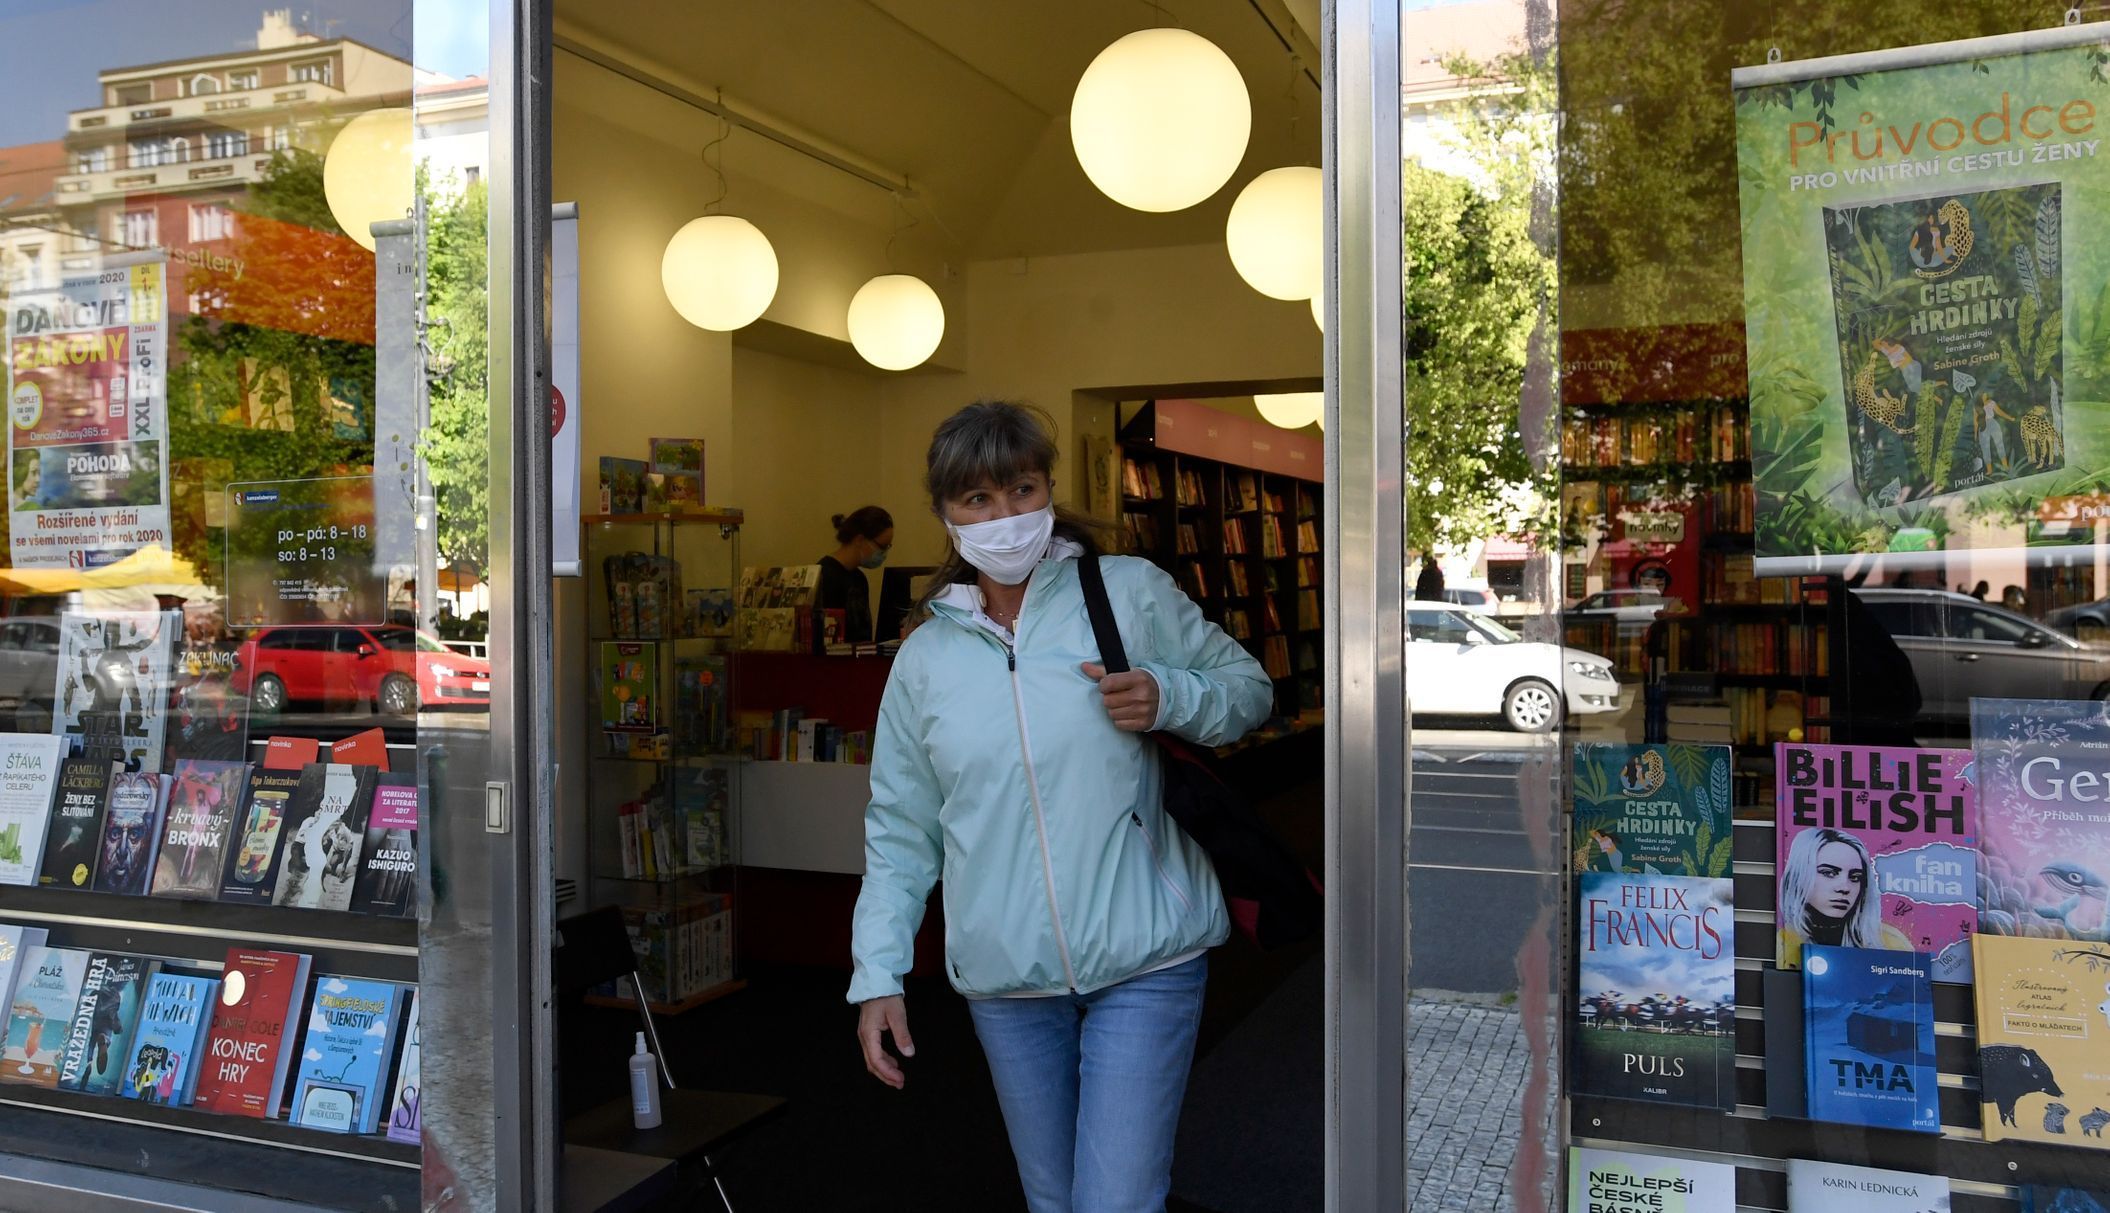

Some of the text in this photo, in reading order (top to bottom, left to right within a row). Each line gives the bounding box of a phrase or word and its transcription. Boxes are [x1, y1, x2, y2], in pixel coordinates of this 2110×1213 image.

[1787, 91, 2097, 169] Průvodce
[1790, 139, 2100, 192] PRO VNITŘNÍ CESTU ŽENY
[99, 271, 125, 284] 2020
[1920, 275, 1999, 307] CESTA
[1910, 297, 2018, 336] HRDINKY
[1937, 328, 1993, 343] Hledání zdrojů
[15, 332, 126, 369] ZÁKONY
[1945, 340, 1986, 353] ženské síly
[1710, 351, 1740, 367] pro
[1934, 351, 2000, 371] Sabine Groth
[135, 399, 151, 436] XXL
[67, 453, 132, 474] POHODA
[1954, 471, 1985, 488] portál
[37, 509, 138, 529] Rozšířené vydání
[16, 529, 163, 546] se všemi novelami pro rok 2020
[278, 529, 294, 544] po
[307, 526, 327, 543] pá:
[330, 525, 337, 539] 8
[352, 525, 367, 539] 18
[278, 550, 296, 561] so:
[299, 547, 307, 561] 8
[320, 547, 336, 560] 13
[66, 710, 148, 738] STAR
[334, 740, 357, 753] novinka
[6, 752, 42, 769] ŠŤÁVA
[2, 772, 47, 782] ŘAPÍKATÉHO
[67, 764, 104, 775] CAMILLA
[5, 783, 34, 791] CELERU
[381, 790, 412, 799] NOBELOVA
[65, 792, 96, 805] ŽENY BEZ
[329, 796, 342, 804] NA
[61, 805, 94, 817] SLITOVÁNÍ
[1625, 800, 1682, 817] CESTA
[1792, 788, 1965, 835] EILISH
[2043, 810, 2083, 821] Příběh
[1616, 818, 1697, 836] HRDINKY
[168, 830, 221, 848] BRONX
[1635, 836, 1676, 846] Hledání zdrojů
[376, 849, 410, 861] KAZUO
[1661, 845, 1671, 853] síly
[368, 859, 415, 872] ISHIGURO
[1631, 854, 1681, 864] Sabine Groth
[1915, 855, 1962, 876] fan
[1885, 871, 1962, 896] kniha
[1621, 885, 1689, 911] FELIX
[1589, 899, 1722, 960] FRANCIS
[39, 964, 63, 978] PLÁŽ
[87, 957, 108, 990] HRA
[1871, 965, 1925, 978] Sigri Sandberg
[153, 978, 197, 1001] MICHAL
[252, 1020, 280, 1036] COLE
[325, 1010, 376, 1029] TAJEMSTVÍ
[2008, 1020, 2031, 1028] FAKTŮ
[2039, 1022, 2082, 1031] MLÁĎATECH
[211, 1037, 268, 1063] KONEC
[219, 1062, 249, 1084] HRY
[1623, 1053, 1684, 1078] PULS
[1829, 1058, 1914, 1093] TMA
[1912, 1119, 1935, 1129] portál
[1589, 1171, 1694, 1194] NEJLEPŠÍ
[1822, 1177, 1919, 1198] KARIN LEDNICKÁ
[1589, 1184, 1663, 1207] ČESKÉ
[1589, 1201, 1664, 1213] BÁS
